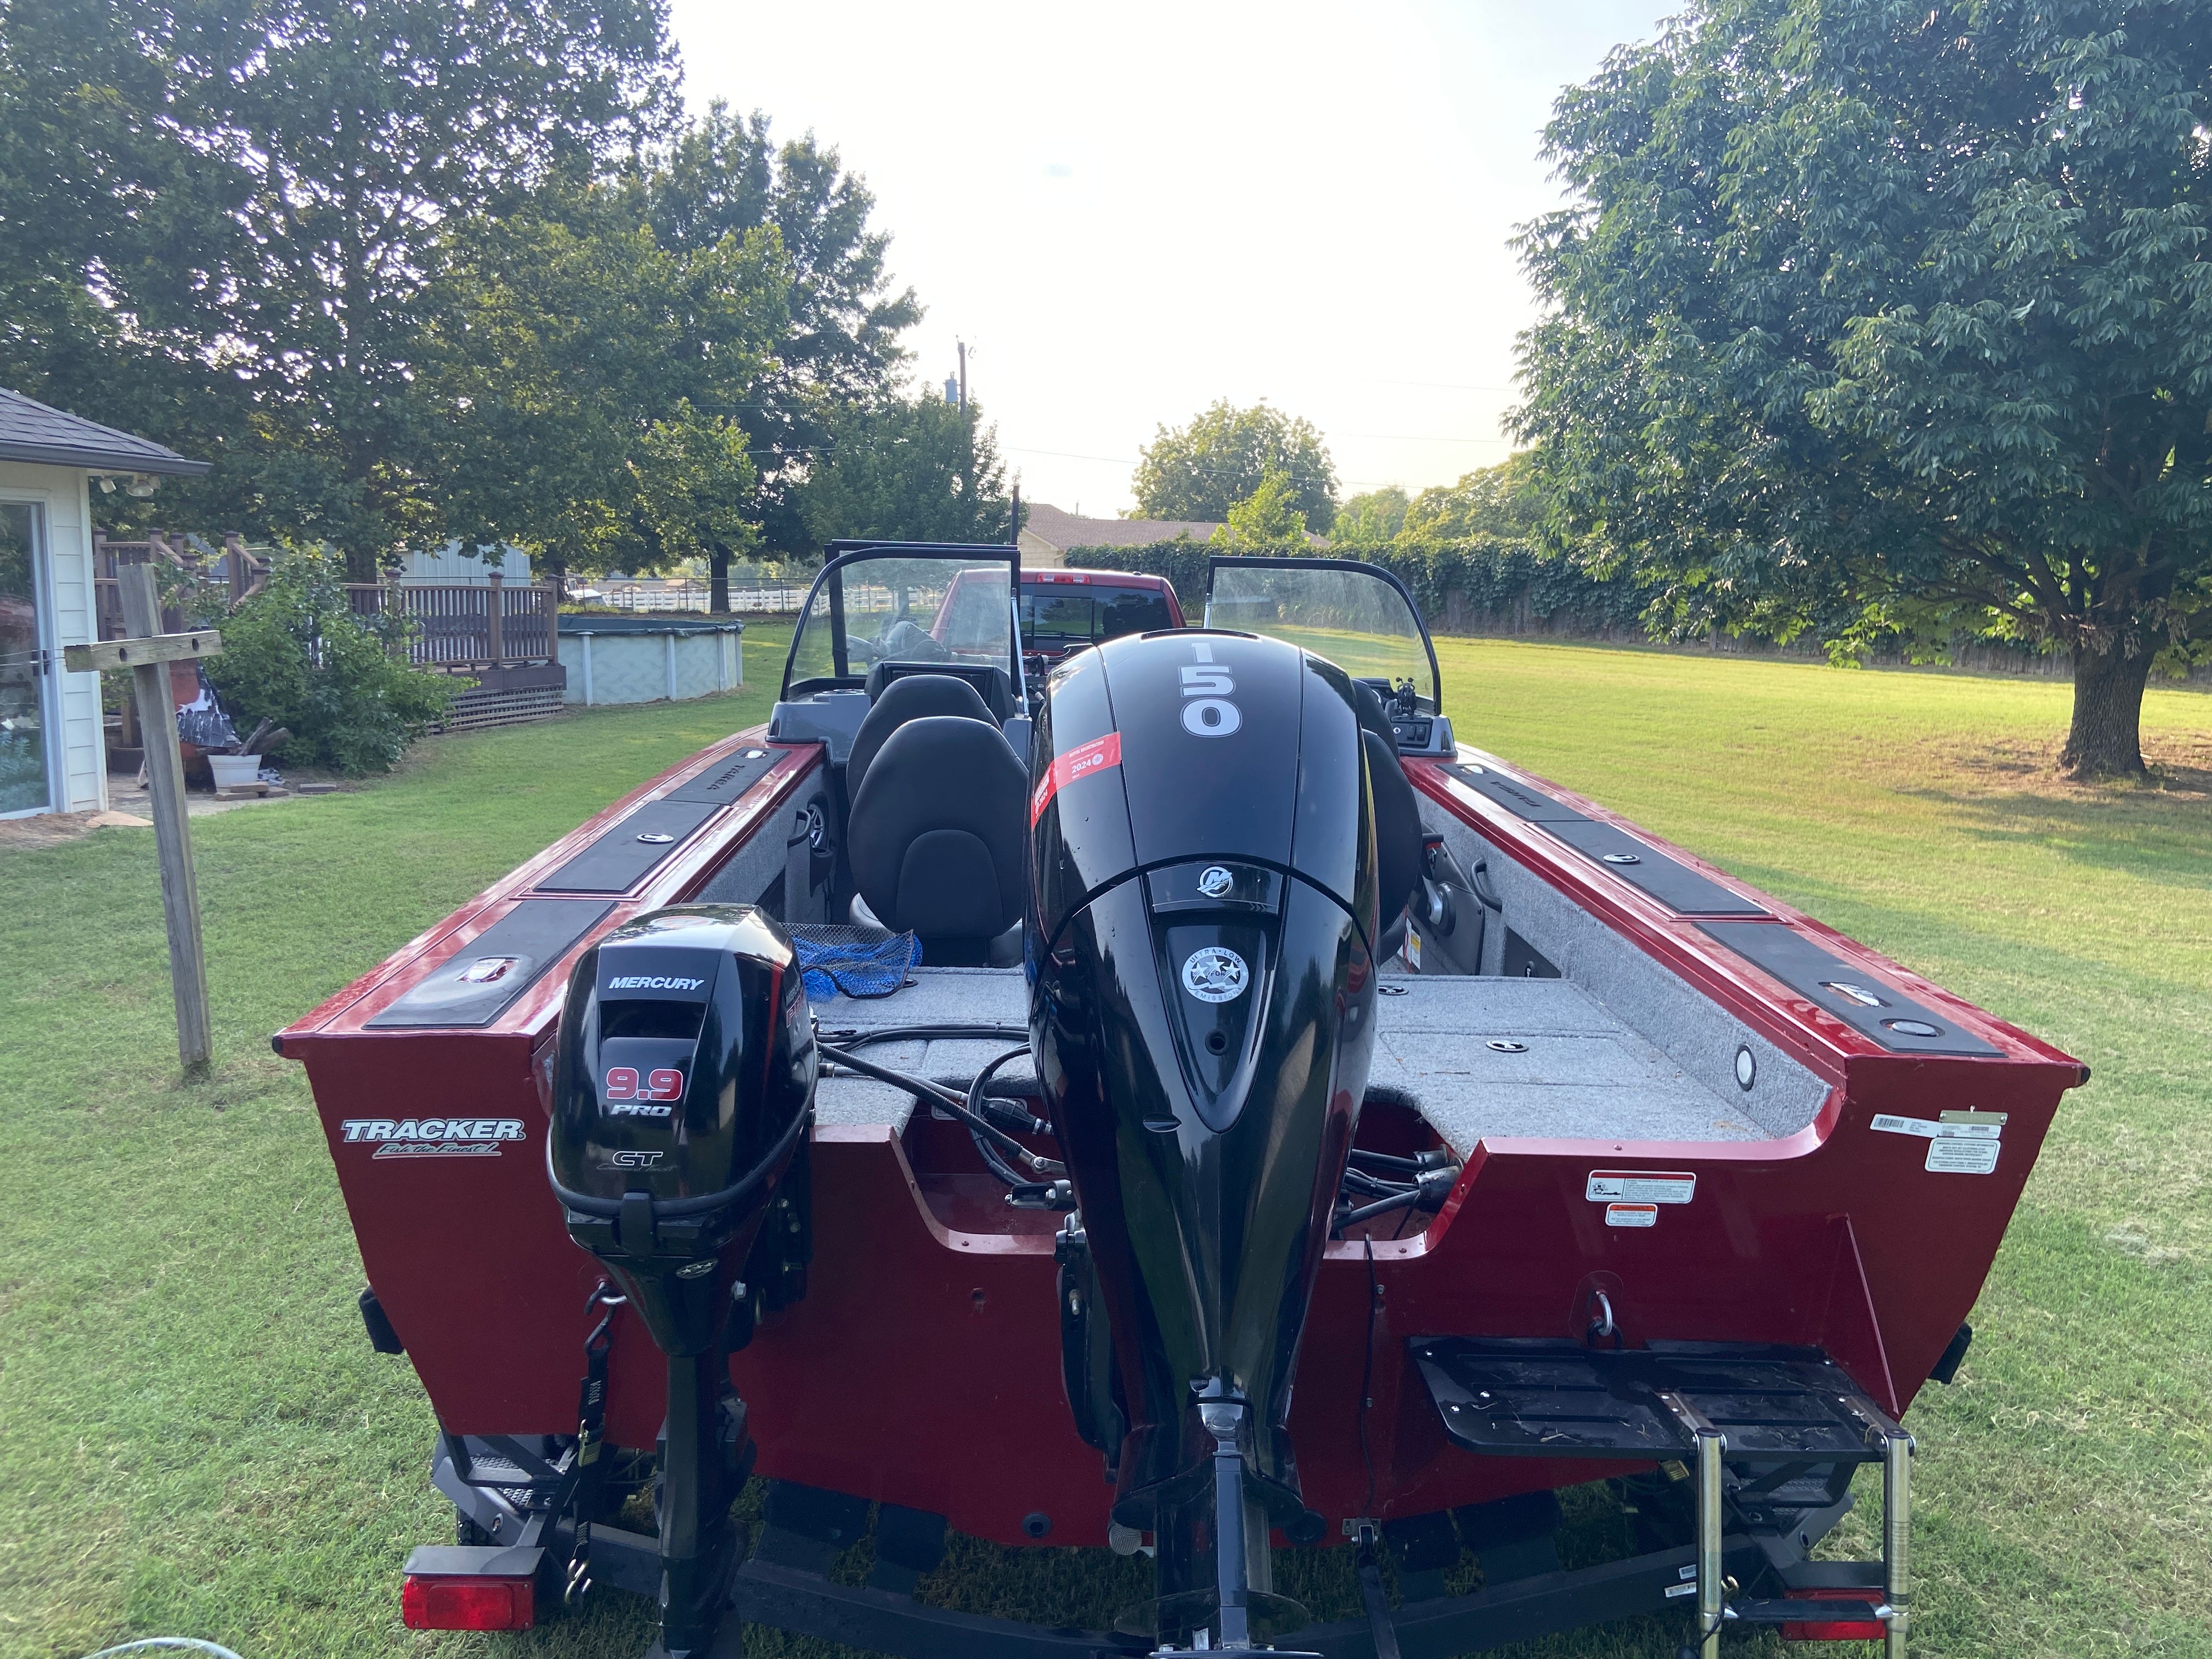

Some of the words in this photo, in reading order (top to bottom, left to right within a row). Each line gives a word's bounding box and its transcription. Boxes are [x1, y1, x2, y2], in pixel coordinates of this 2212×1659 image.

[1179, 642, 1242, 737] 150
[1071, 759, 1091, 774] 2024
[1189, 948, 1217, 963] ULTRA
[1223, 950, 1242, 964] LOW
[608, 977, 705, 990] MERCURY
[1195, 989, 1239, 1001] EMISSION
[606, 1066, 684, 1101] 9.9
[611, 1104, 673, 1116] PRO
[344, 1120, 523, 1141] TRACKER
[379, 1144, 411, 1153] Fish
[413, 1143, 436, 1153] the
[612, 1150, 663, 1166] CT
